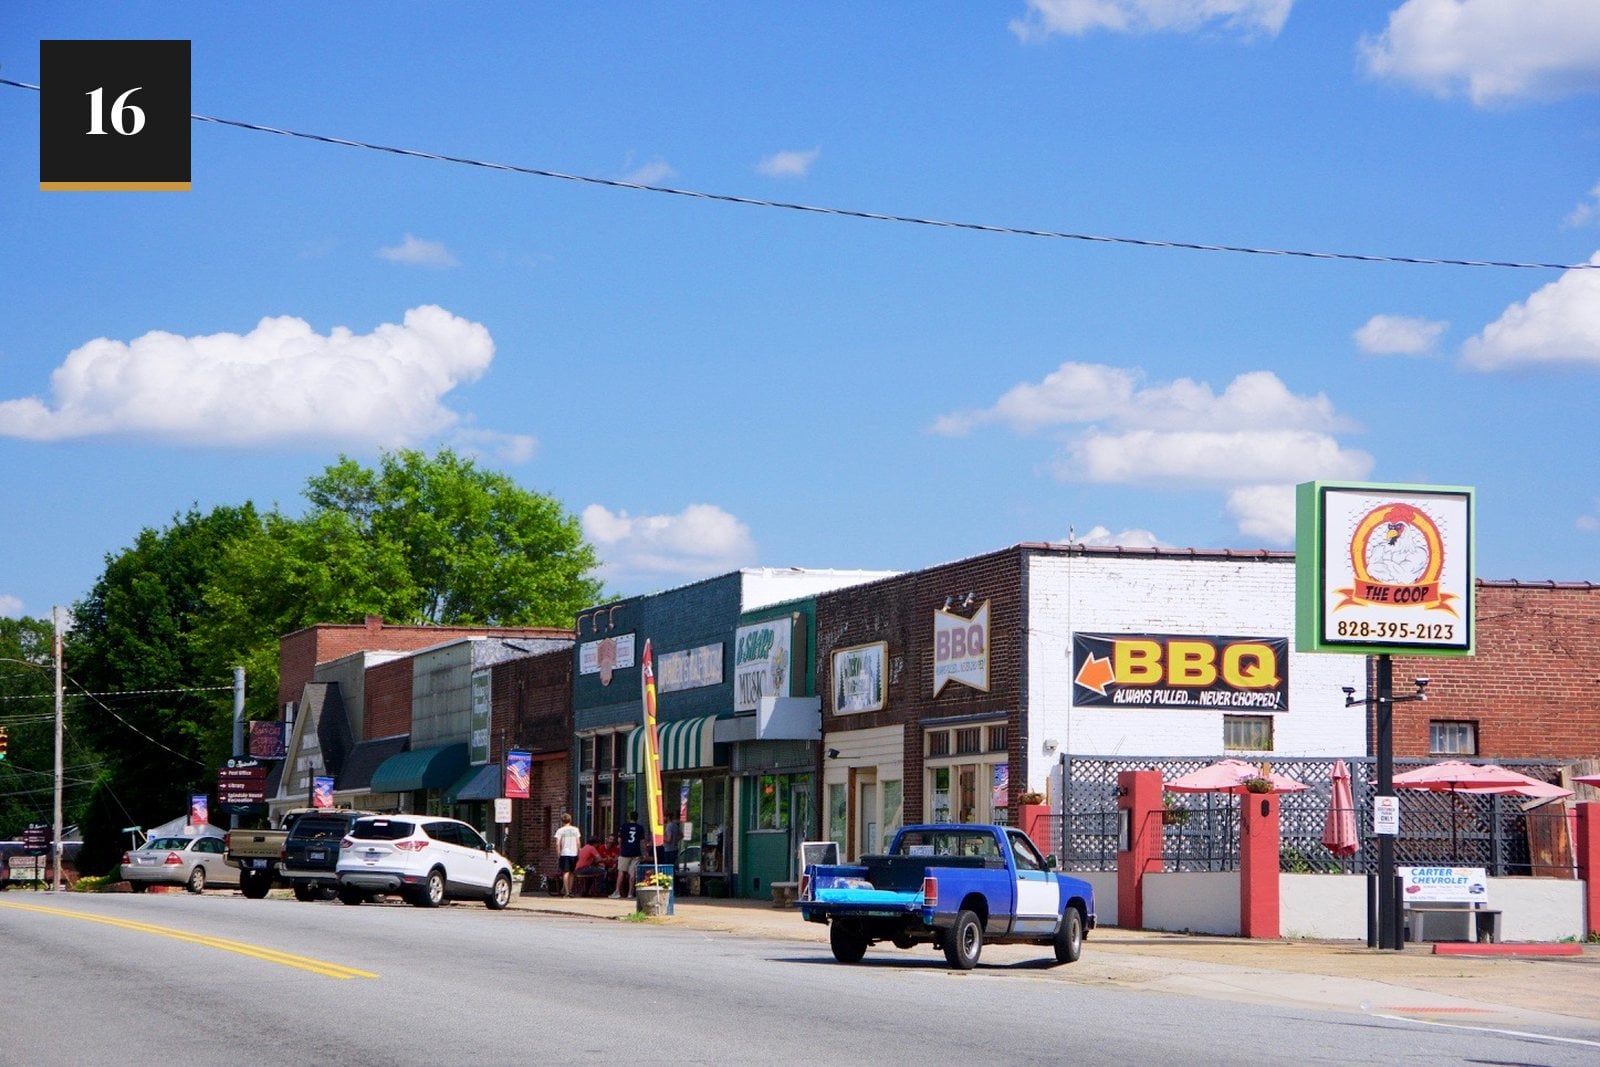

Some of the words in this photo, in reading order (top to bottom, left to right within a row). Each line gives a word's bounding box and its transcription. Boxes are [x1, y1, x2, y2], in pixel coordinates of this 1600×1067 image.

[1365, 585, 1390, 601] THE
[1393, 586, 1430, 603] COOP
[1337, 620, 1454, 640] 828-395-2123
[936, 624, 984, 661] BBQ
[1113, 638, 1284, 689] BBQ
[739, 669, 767, 705] MUSIC
[1113, 689, 1152, 704] ALWAYS
[1200, 691, 1232, 707] NEVER
[1232, 691, 1281, 709] CHOPPED!
[627, 831, 636, 843] 3
[1411, 868, 1453, 876] CARTER
[1411, 877, 1469, 885] CHEVROLET
